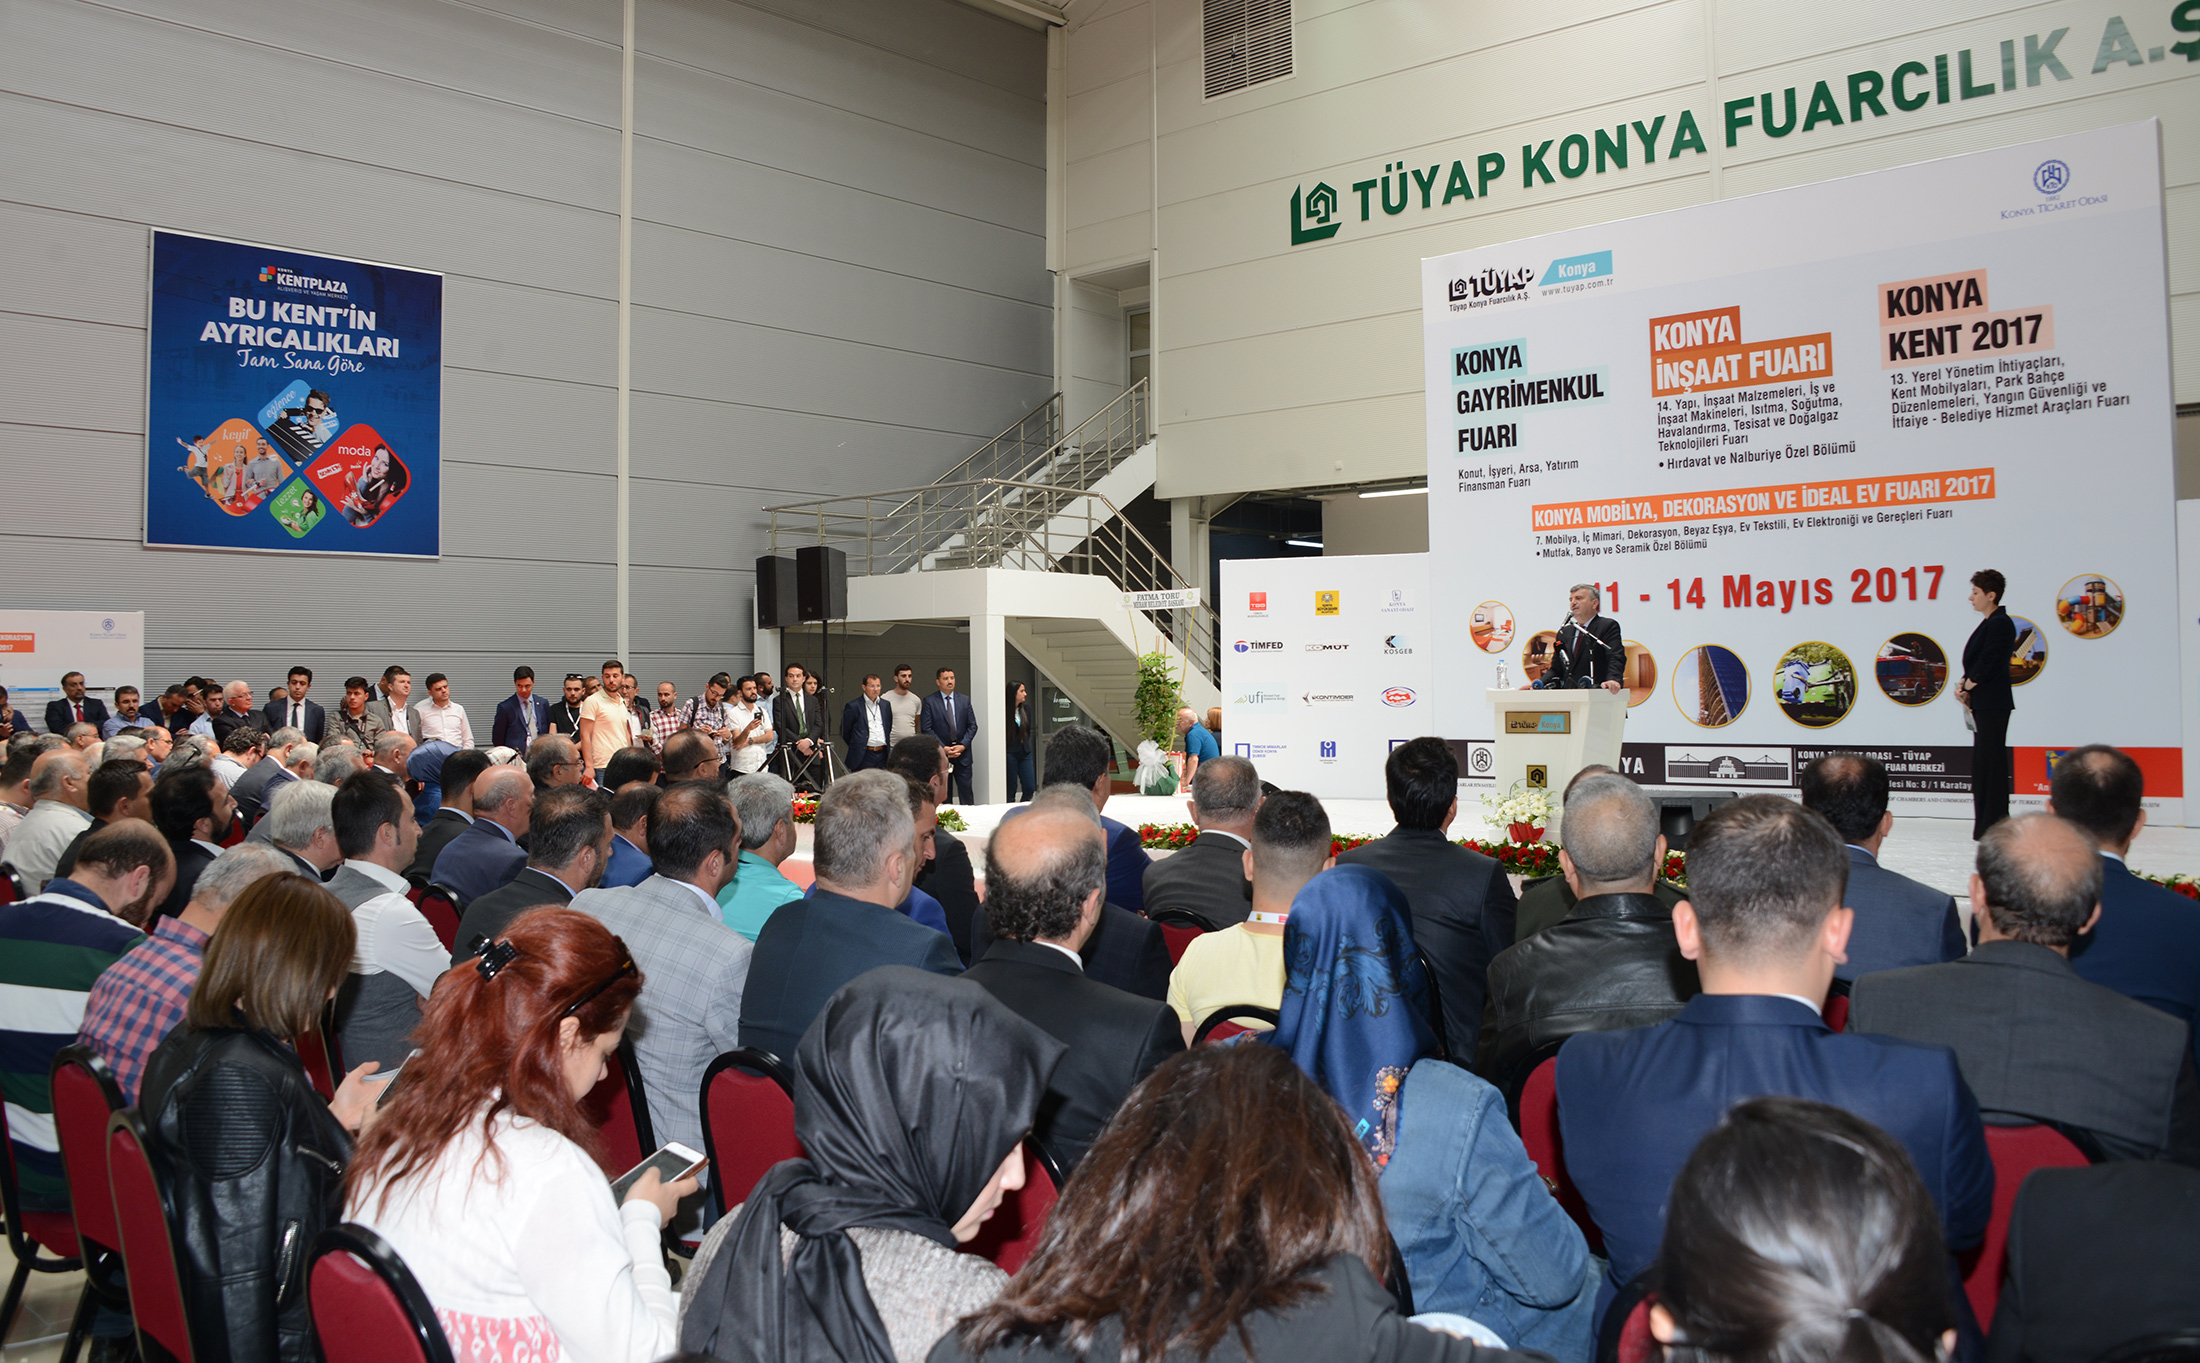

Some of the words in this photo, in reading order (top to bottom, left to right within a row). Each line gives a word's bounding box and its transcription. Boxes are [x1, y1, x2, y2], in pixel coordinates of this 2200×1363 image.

[1353, 151, 1506, 222] TÜYAP
[1522, 109, 1708, 189] KONYA
[1724, 26, 2074, 149] FUARCILIK
[2000, 208, 2035, 220] KONYA
[2078, 194, 2108, 207] ODASI
[276, 272, 349, 295] KENTPLAZA
[1469, 266, 1535, 298] TÜYAP
[1558, 261, 1596, 278] Konya
[1449, 302, 1468, 313] Tüyap
[1468, 299, 1488, 309] Konya
[1488, 294, 1516, 306] Fuarcılık
[1516, 291, 1530, 302] A.Ş.
[1541, 278, 1614, 297] www.tuyap.com.tr
[1887, 277, 1983, 319] KONYA
[228, 296, 267, 321] BU
[272, 300, 377, 332] KENT'İN
[200, 321, 400, 359] AYRICALIKLARI
[1654, 314, 1736, 352] KONYA
[1889, 324, 1962, 362] KENT
[1972, 313, 2043, 352] 2017
[237, 349, 280, 369] Tam
[282, 351, 326, 371] Sana
[327, 354, 366, 377] Göre
[1455, 344, 1523, 377] KONYA
[1656, 353, 1743, 394] İNŞAAT
[1748, 342, 1826, 379] FUARI
[1891, 373, 1908, 386] 13.
[1912, 369, 1942, 383] Yerel
[1945, 362, 1995, 379] Yönetim
[1998, 356, 2065, 375] İhtiyaçları,
[1456, 373, 1605, 415] GAYRİMENKUL
[1657, 400, 1673, 412] 14.
[1675, 398, 1700, 412] Yapı,
[1703, 394, 1735, 408] İnşaat
[1738, 385, 1806, 402] Malzemeleri,
[1809, 381, 1820, 395] İş
[1822, 382, 1836, 393] ve
[1891, 387, 1917, 400] Kent
[1920, 380, 1991, 397] Mobilyaları,
[1995, 375, 2024, 389] Park
[2027, 371, 2065, 387] Bahçe
[1892, 397, 1980, 414] Düzenlemeleri,
[1983, 390, 2025, 405] Yangın
[2028, 381, 2088, 401] Güvenliği
[2092, 381, 2108, 393] ve
[266, 389, 297, 420] eğlence
[1657, 412, 1688, 427] İnşaat
[1690, 406, 1748, 422] Makineleri,
[1751, 402, 1788, 416] Isıtma,
[1791, 396, 1843, 412] Soğutma,
[1892, 413, 1929, 429] İtfaiye
[1941, 406, 1992, 425] Belediye
[1996, 404, 2039, 419] Hizmet
[2042, 399, 2093, 416] Araçları
[2096, 394, 2131, 408] Fuarı
[222, 428, 253, 443] keyif
[1458, 423, 1518, 453] FUARI
[1658, 422, 1731, 439] Havalandırma,
[1733, 416, 1771, 431] Tesisat
[1773, 416, 1786, 427] ve
[1789, 411, 1839, 427] Doğalgaz
[338, 444, 372, 457] moda
[1658, 438, 1719, 452] Teknolojileri
[1722, 433, 1749, 447] Fuarı
[1667, 455, 1712, 470] Hırdavat
[1714, 454, 1727, 465] ve
[1730, 448, 1782, 464] Nalburiye
[1785, 443, 1810, 458] Özel
[1813, 440, 1857, 456] Bölümü
[1458, 467, 1486, 480] Konut,
[1488, 464, 1516, 479] İşyeri,
[1518, 463, 1543, 474] Arsa,
[1545, 459, 1579, 471] Yatırım
[275, 485, 299, 508] lezzet
[1458, 479, 1506, 493] Finansman
[1508, 477, 1531, 489] Fuarı
[1534, 507, 1583, 528] KONYA
[1586, 500, 1658, 524] MOBİLYA,
[1662, 491, 1770, 518] DEKORASYON
[1774, 489, 1798, 510] VE
[1801, 485, 1853, 508] İDEAL
[1856, 482, 1881, 504] EV
[1885, 478, 1941, 502] FUARI
[1945, 474, 1992, 498] 2017
[1535, 536, 1543, 546] 7.
[1545, 533, 1581, 546] Mobilya,
[1582, 530, 1591, 545] İç
[1592, 529, 1626, 542] Mimari,
[1627, 525, 1681, 541] Dekorasyon,
[1683, 524, 1710, 538] Beyaz
[1712, 523, 1737, 536] Eşya,
[1740, 521, 1751, 533] Ev
[1754, 518, 1790, 532] Tekstili,
[1793, 517, 1804, 530] Ev
[1807, 513, 1859, 528] Elektroniği
[1862, 514, 1874, 525] ve
[1876, 509, 1924, 525] Gereçleri
[1926, 507, 1953, 520] Fuarı
[1542, 546, 1574, 560] Mutfak,
[1576, 544, 1602, 558] Banyo
[1603, 545, 1613, 556] ve
[1615, 541, 1651, 555] Seramik
[1653, 538, 1673, 552] Özel
[1674, 537, 1708, 552] Bölümü
[1137, 593, 1159, 601] FATMA
[1160, 592, 1180, 600] TORU
[1594, 581, 1619, 613] 1
[1640, 594, 1650, 602] -
[1667, 577, 1706, 611] 14
[1722, 574, 1833, 614] Mayıs
[1850, 564, 1944, 604] 2017
[1250, 640, 1284, 650] TİMFED
[1248, 690, 1263, 704] ufi
[1541, 721, 1562, 729] Konya
[1798, 751, 1825, 759] KONYA
[1902, 750, 1932, 761] TÜYAP
[1885, 763, 1907, 773] FUAR
[1908, 762, 1945, 773] MERKEZİ
[1905, 780, 1920, 789] No:
[1920, 780, 1926, 789] 8
[1933, 781, 1938, 789] 1
[1940, 781, 1972, 791] Karatay
